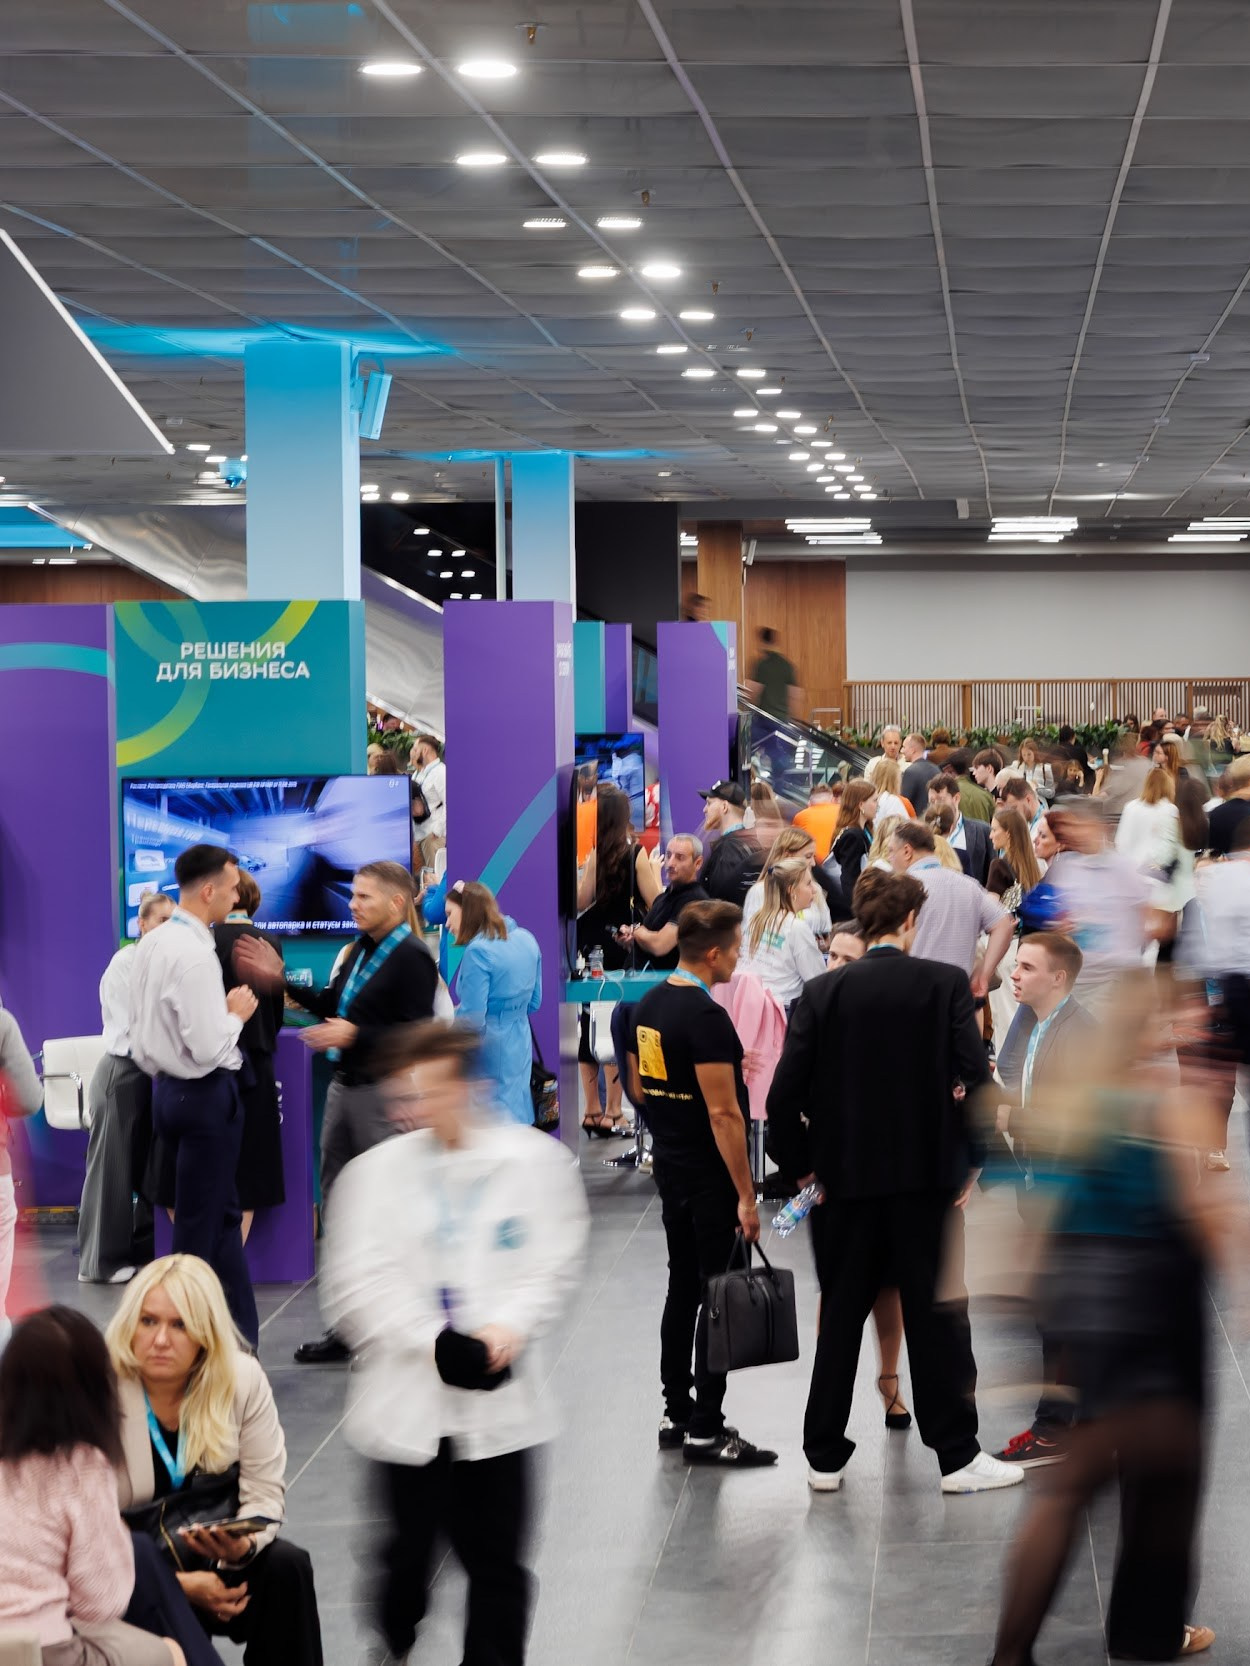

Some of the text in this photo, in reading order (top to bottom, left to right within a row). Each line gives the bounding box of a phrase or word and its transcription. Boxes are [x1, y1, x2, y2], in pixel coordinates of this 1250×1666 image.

[180, 641, 286, 660] РЕШЕНИЯ
[156, 661, 310, 682] ДЛЯ БИЗНЕСА
